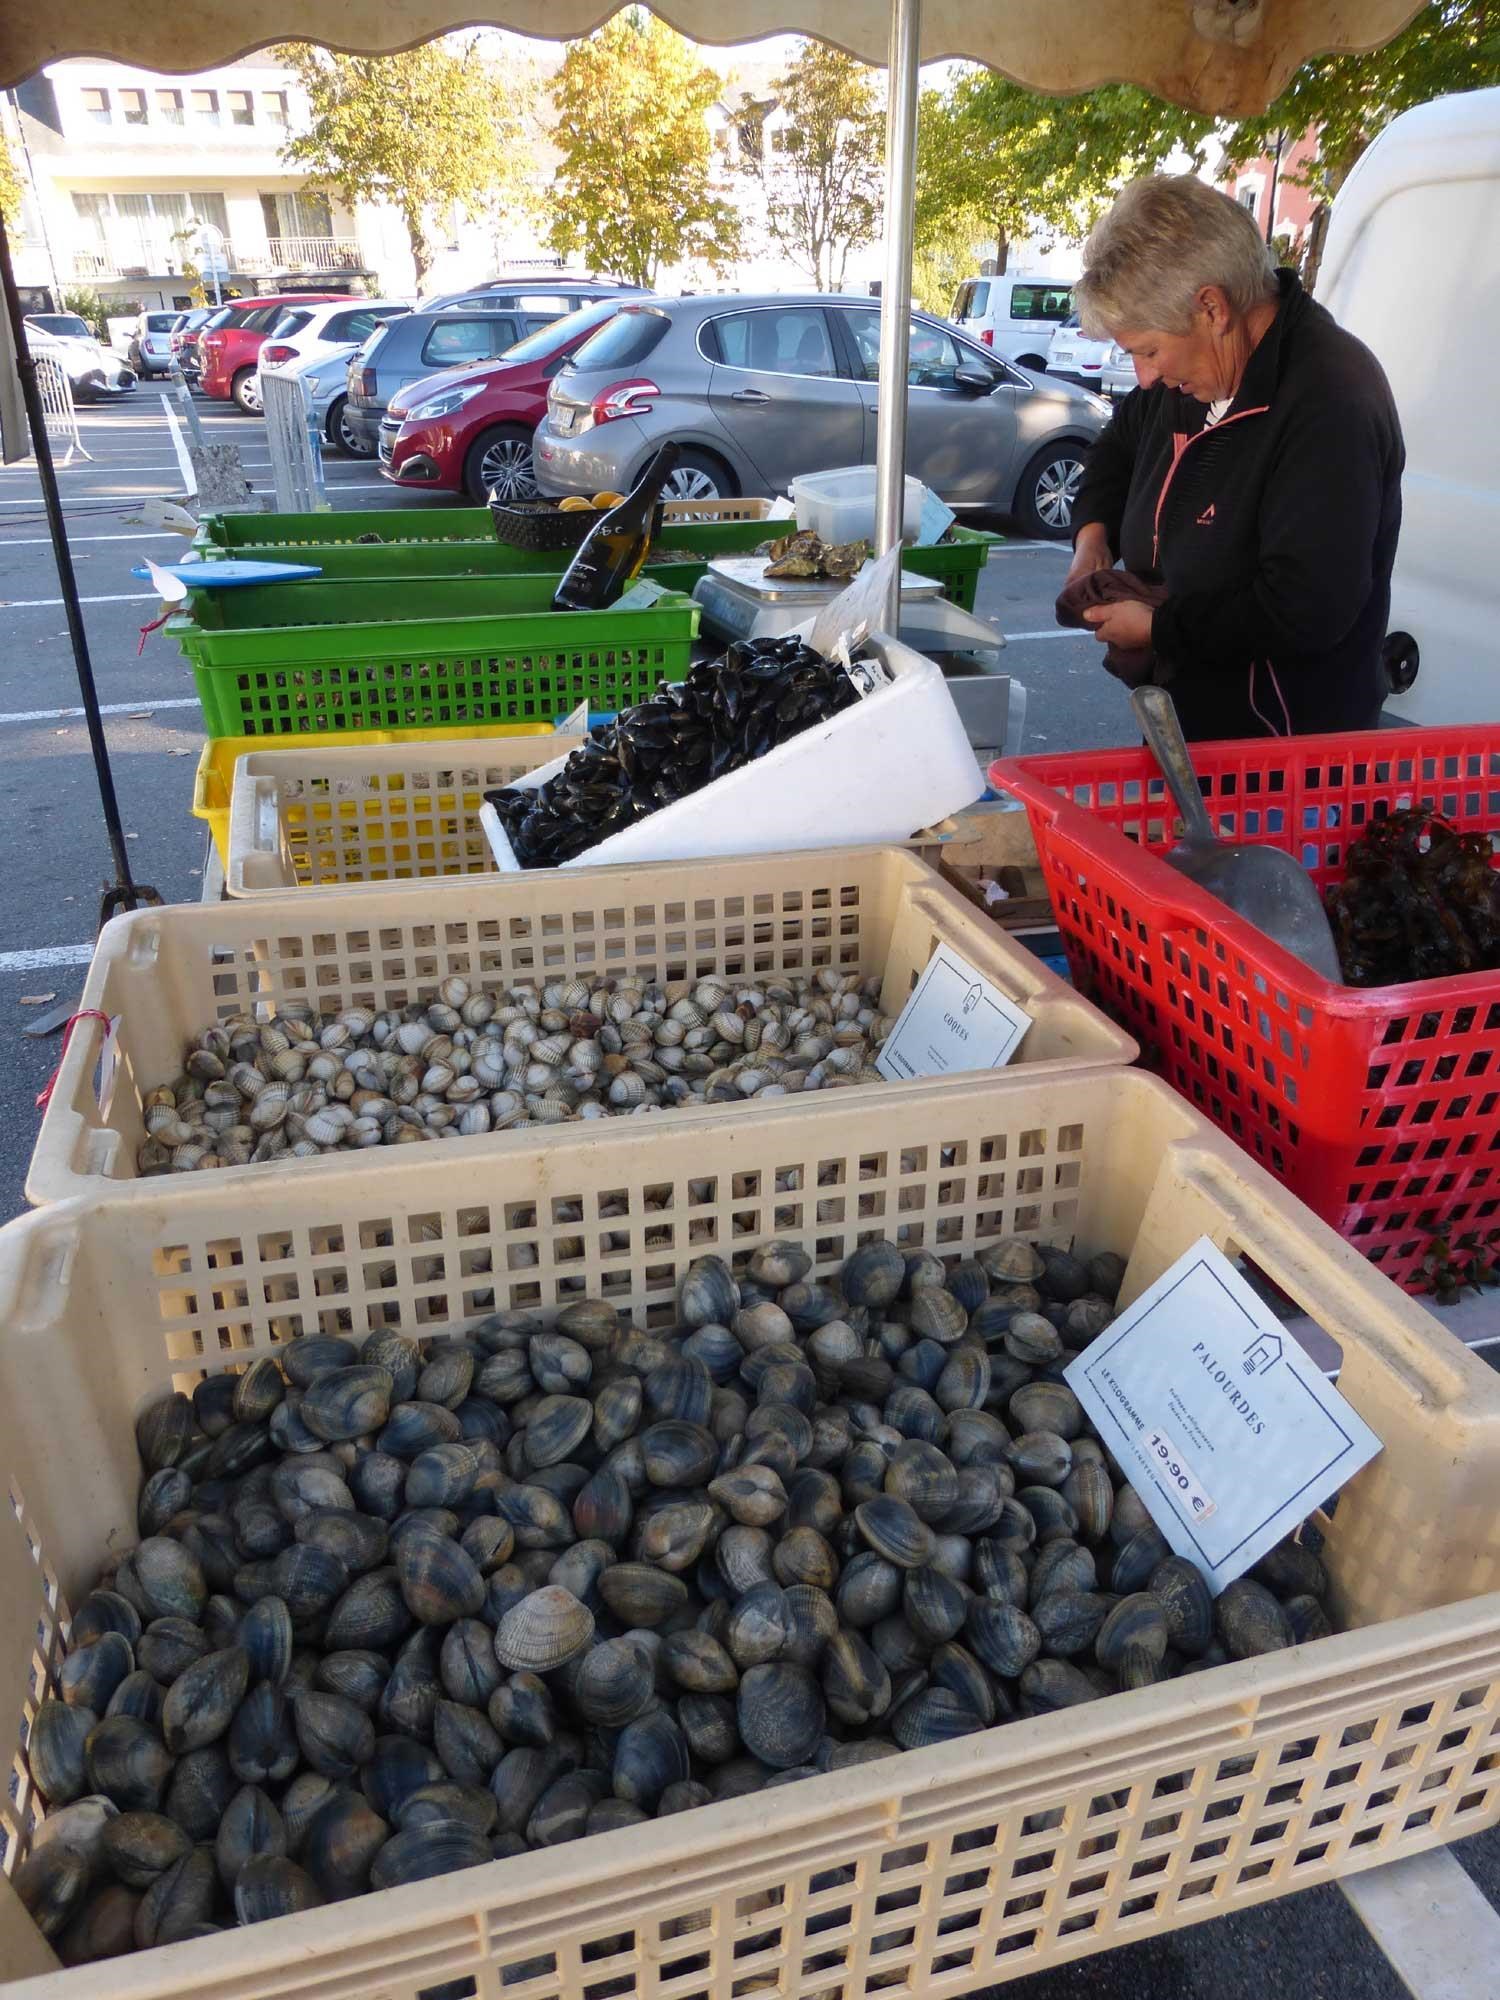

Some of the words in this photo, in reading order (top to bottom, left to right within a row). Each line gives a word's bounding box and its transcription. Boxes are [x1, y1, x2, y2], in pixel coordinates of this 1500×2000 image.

[943, 1012, 969, 1041] COQUES
[1192, 1341, 1264, 1435] PALOURDES
[1101, 1368, 1111, 1379] LE
[1108, 1379, 1145, 1431] KILOGRAMME
[1150, 1434, 1190, 1491] 19,90
[1190, 1495, 1205, 1513] €
